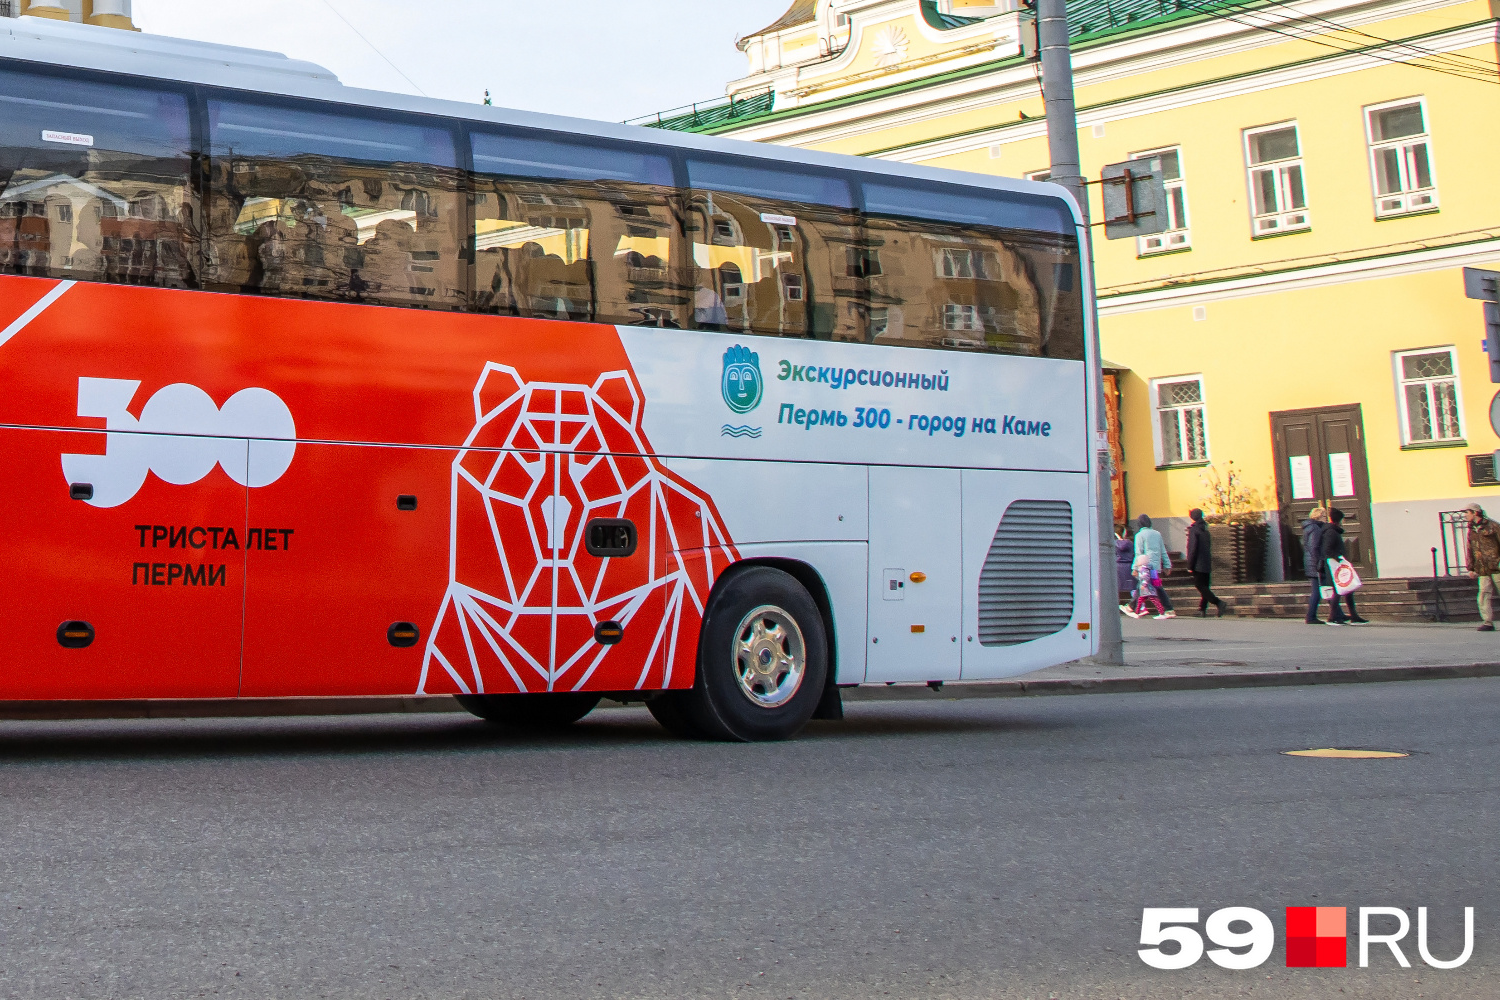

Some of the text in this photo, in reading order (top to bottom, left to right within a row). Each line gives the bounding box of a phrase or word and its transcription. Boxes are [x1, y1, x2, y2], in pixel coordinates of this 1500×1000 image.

[776, 359, 949, 391] Экскурсионный
[777, 403, 848, 430] Пермь
[852, 407, 891, 429] 300
[908, 414, 967, 438] город
[971, 417, 997, 434] на
[1001, 415, 1052, 437] Каме
[60, 376, 297, 508] 300
[134, 524, 295, 551] ТРИСТА ЛЕТ
[132, 562, 226, 587] ПЕРМИ
